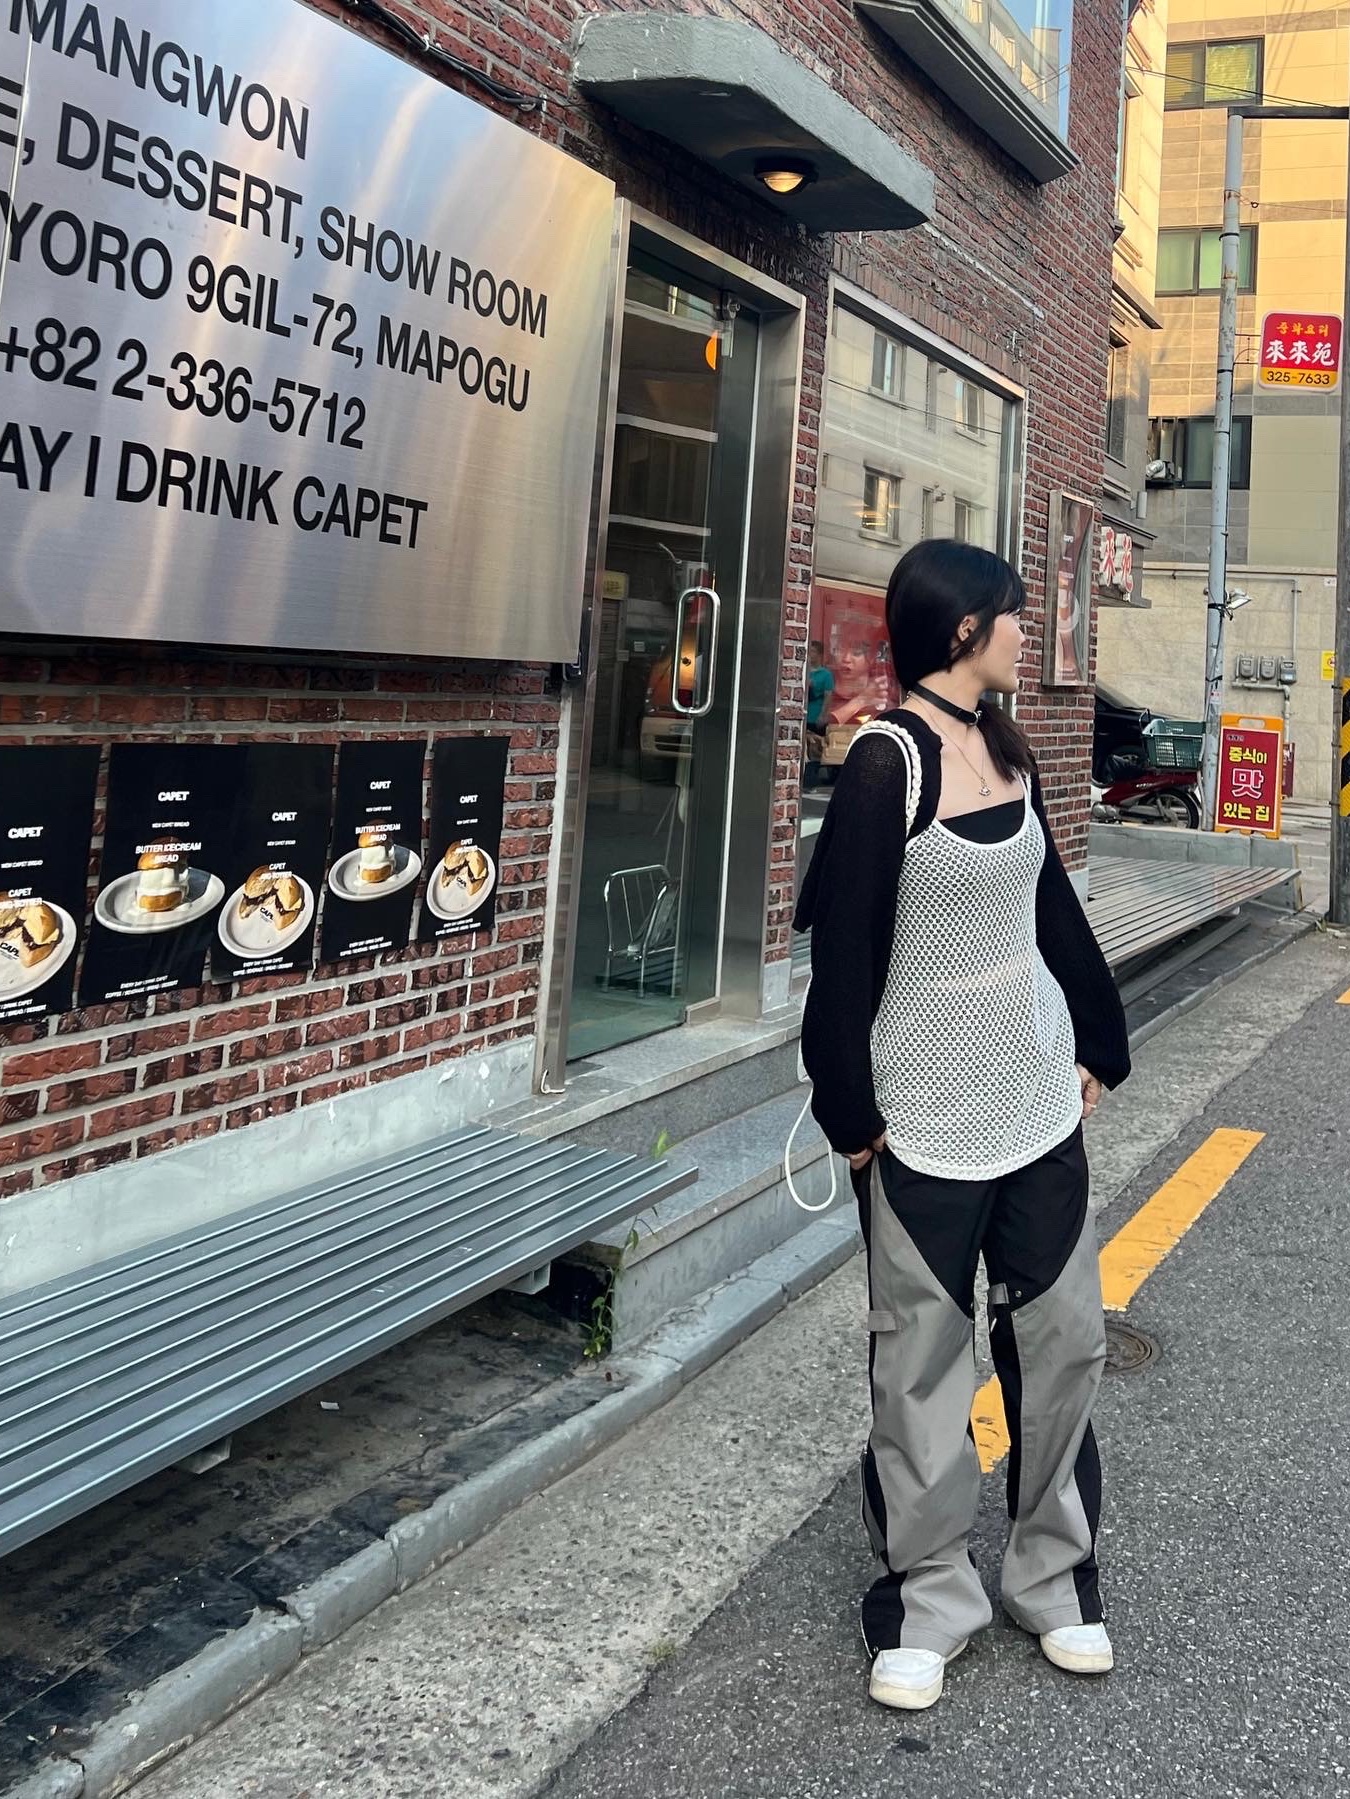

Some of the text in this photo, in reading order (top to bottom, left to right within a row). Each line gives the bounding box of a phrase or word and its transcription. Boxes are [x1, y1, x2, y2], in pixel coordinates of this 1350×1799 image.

[9, 0, 309, 160] MANGWON
[56, 101, 304, 259] DESSERT,
[317, 206, 441, 296] SHOW
[447, 256, 548, 339] ROOM
[186, 255, 363, 369] 9GIL-72,
[376, 315, 530, 412] MAPOGU
[1265, 339, 1335, 366] 來來苑
[0, 317, 366, 450] +82 2-336-5712
[1266, 370, 1330, 385] 325-7633
[0, 422, 429, 549] AY I DRINK CAPET
[1229, 746, 1267, 764] 중식이
[369, 780, 391, 790] CAPET
[1231, 768, 1264, 799] 맛
[158, 790, 190, 801] CAPET
[460, 795, 478, 804] CAPET
[272, 811, 297, 822] CAPET
[1223, 802, 1270, 822] 있는 집
[8, 826, 43, 839] CAPET
[135, 842, 202, 854] BUTTER ICECREAM
[8, 887, 33, 898] CAPET
